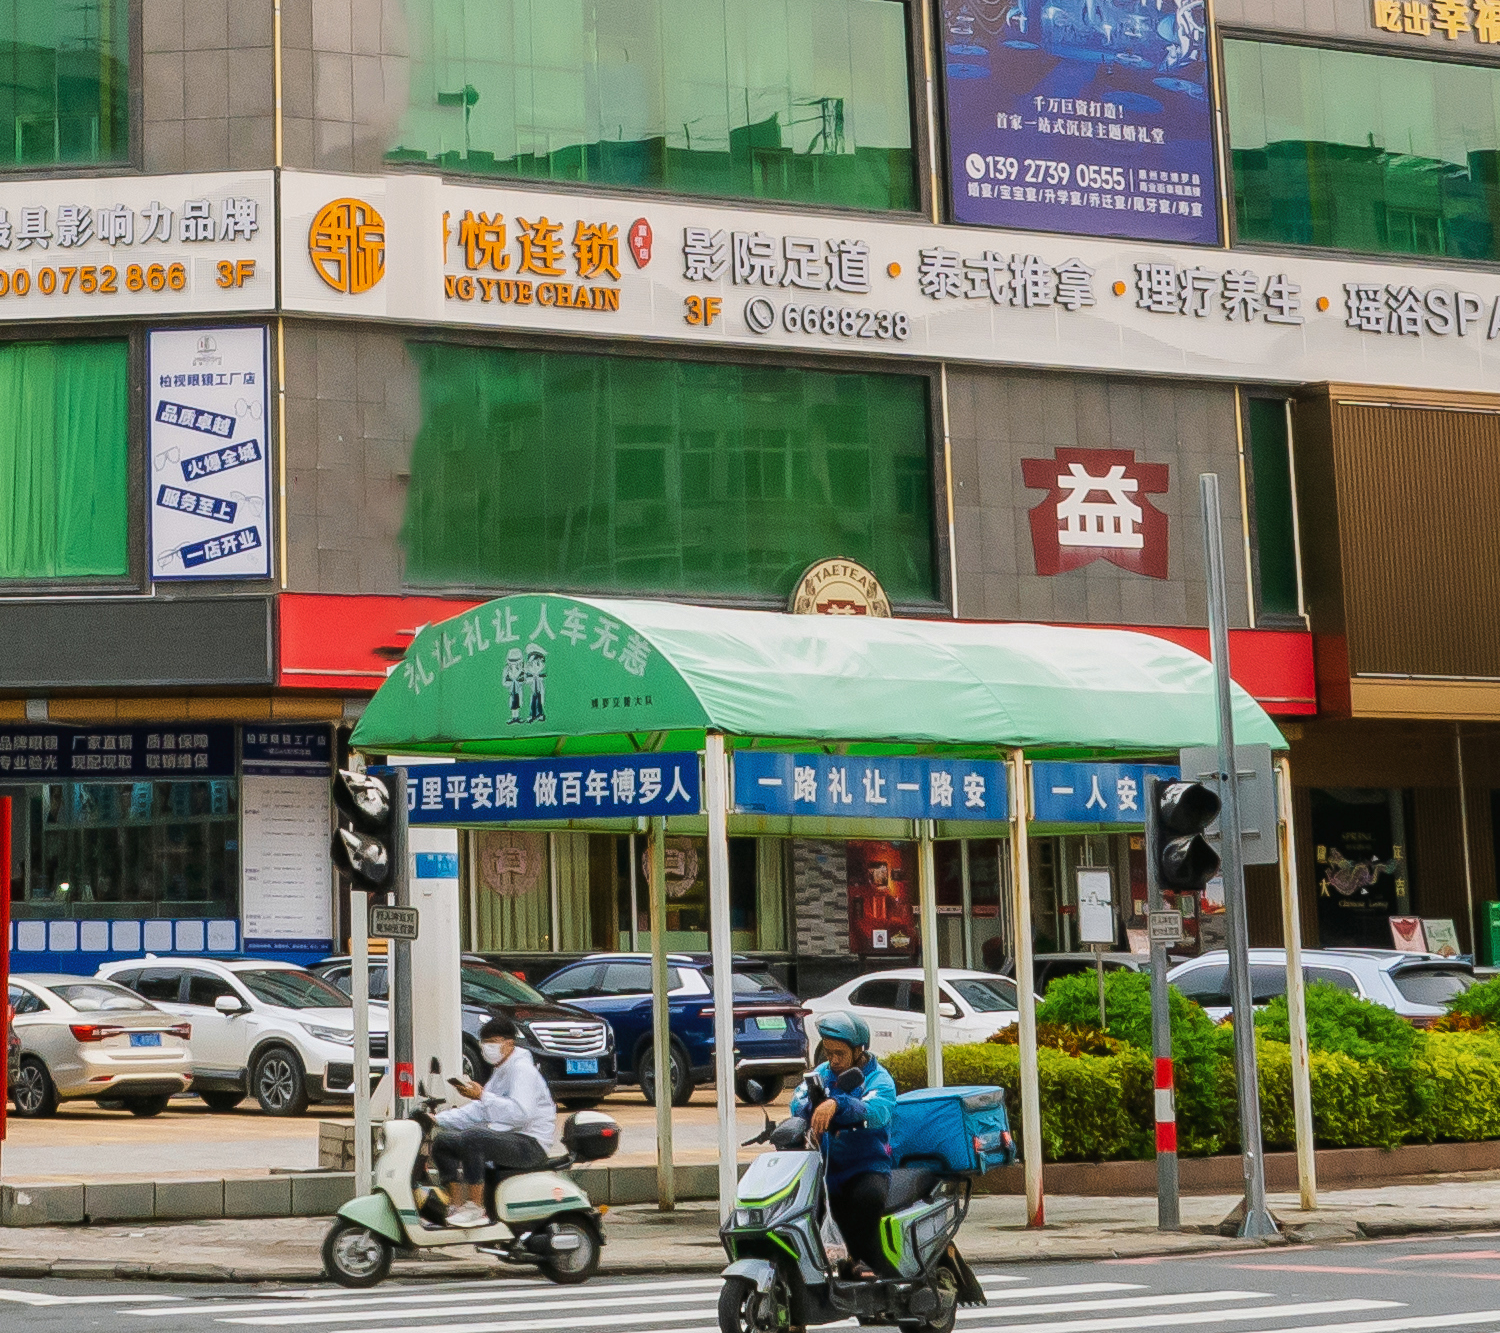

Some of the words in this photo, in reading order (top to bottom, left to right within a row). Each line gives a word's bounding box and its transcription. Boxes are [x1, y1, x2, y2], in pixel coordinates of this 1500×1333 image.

[985, 155, 1018, 180] 139
[1024, 158, 1070, 185] 2739
[1076, 164, 1126, 191] 0555
[442, 209, 622, 280] 悦连锁
[215, 258, 257, 290] 3F
[683, 226, 872, 294] 影院足道
[917, 244, 1096, 312] 泰式推拿
[1134, 262, 1306, 328] 理疗养生
[478, 278, 533, 305] YUE
[537, 282, 622, 312] CHAIN
[684, 295, 723, 327] 3F
[782, 302, 911, 341] 6688238
[159, 372, 256, 388] 柏视眼镜工厂店
[161, 403, 232, 436] 品质卓越
[187, 442, 259, 479] 火爆全城
[161, 487, 232, 521] 服务至上
[1055, 462, 1144, 549] 益
[186, 529, 258, 561] 一店开业
[813, 564, 867, 588] TAETEA
[0, 755, 58, 771] 专业验光
[533, 766, 692, 808] 做百年博罗人
[758, 766, 986, 808] 一路礼让一路安
